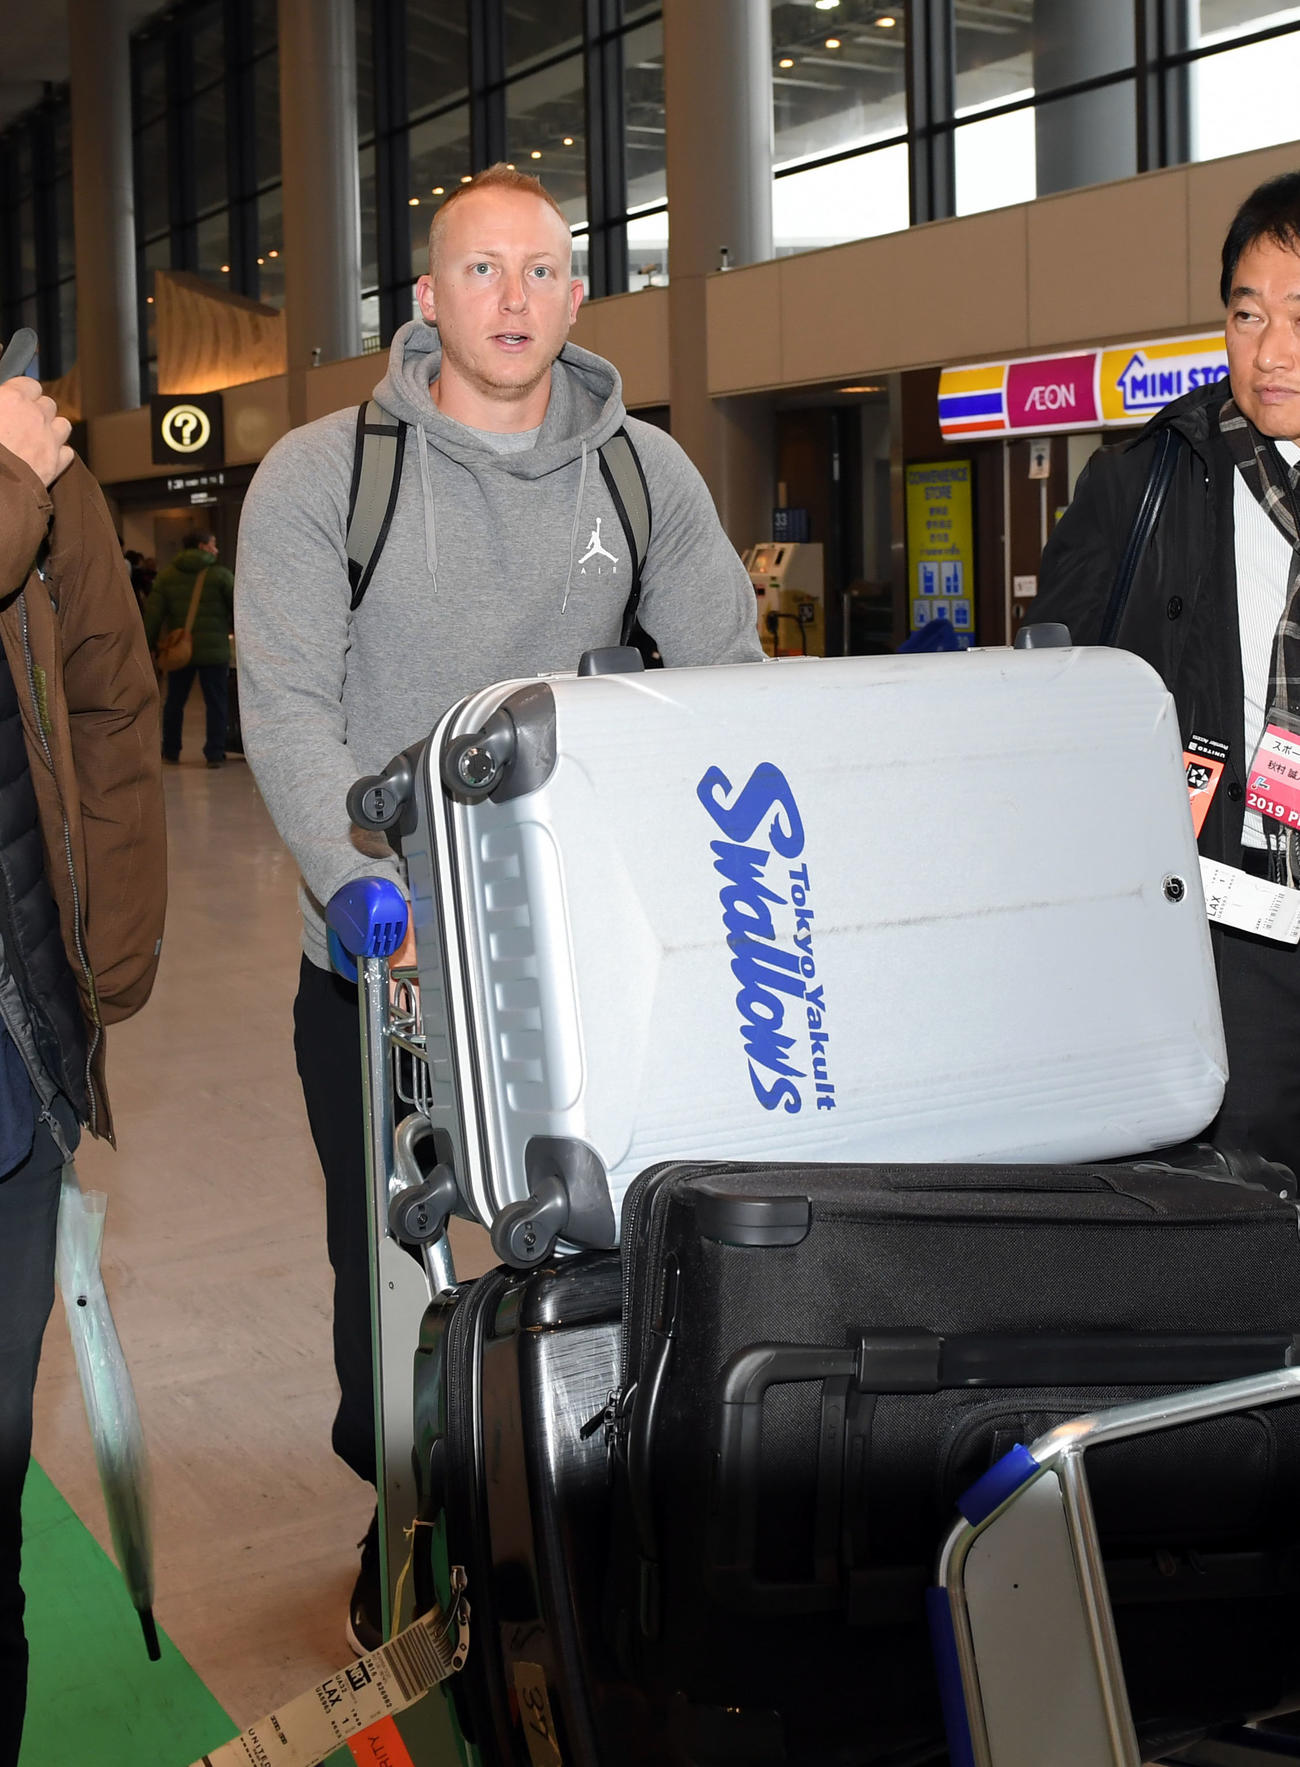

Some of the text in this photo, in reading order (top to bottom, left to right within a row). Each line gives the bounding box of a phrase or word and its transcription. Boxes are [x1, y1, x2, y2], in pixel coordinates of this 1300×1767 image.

[1131, 370, 1182, 399] MINI
[1197, 746, 1226, 758] UNITED
[1247, 793, 1285, 818] 2019
[1206, 895, 1221, 917] LAX
[697, 762, 806, 1113] Swallows
[788, 862, 836, 1111] Tokyo Yakult
[335, 1674, 348, 1694] UA32
[346, 1664, 369, 1690] NRT
[321, 1679, 343, 1707] LAX
[248, 1728, 271, 1767] UNITED
